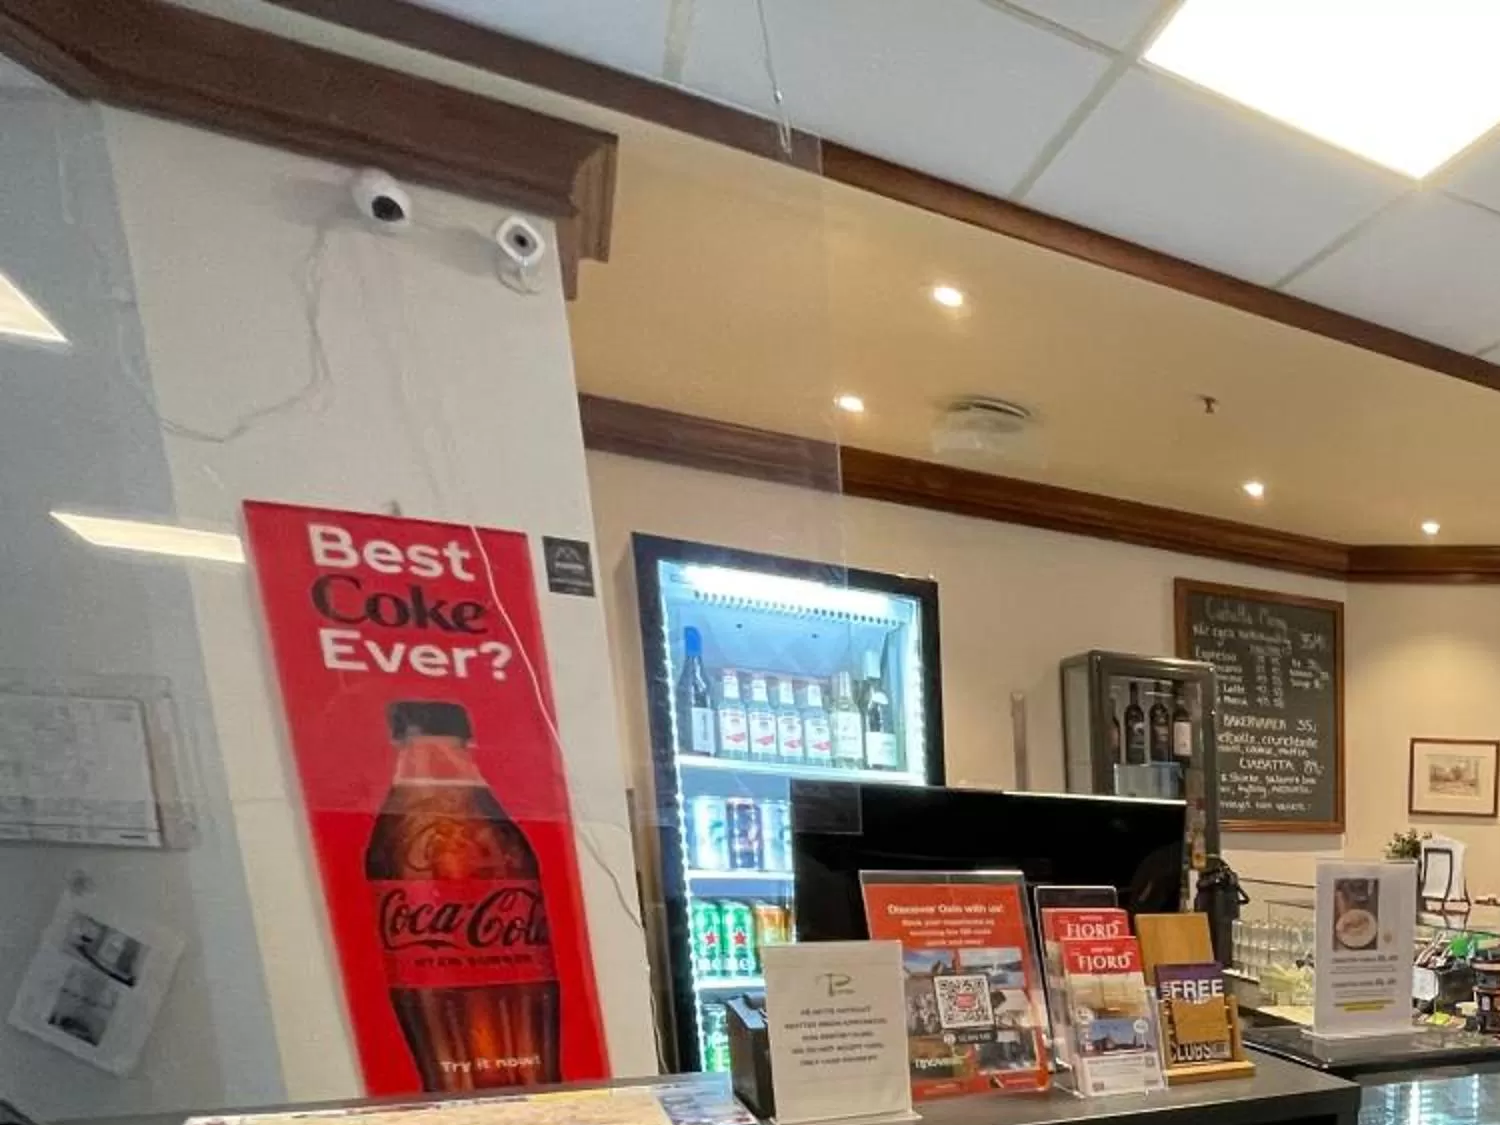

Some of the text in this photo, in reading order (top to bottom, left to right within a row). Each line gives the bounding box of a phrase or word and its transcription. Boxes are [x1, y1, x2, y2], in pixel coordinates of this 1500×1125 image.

[308, 523, 475, 581] Best
[310, 574, 487, 634] Coke
[318, 628, 513, 680] Ever?
[1078, 955, 1131, 972] FJORD
[1170, 978, 1225, 999] FREE
[438, 1055, 541, 1074] Try it now!
